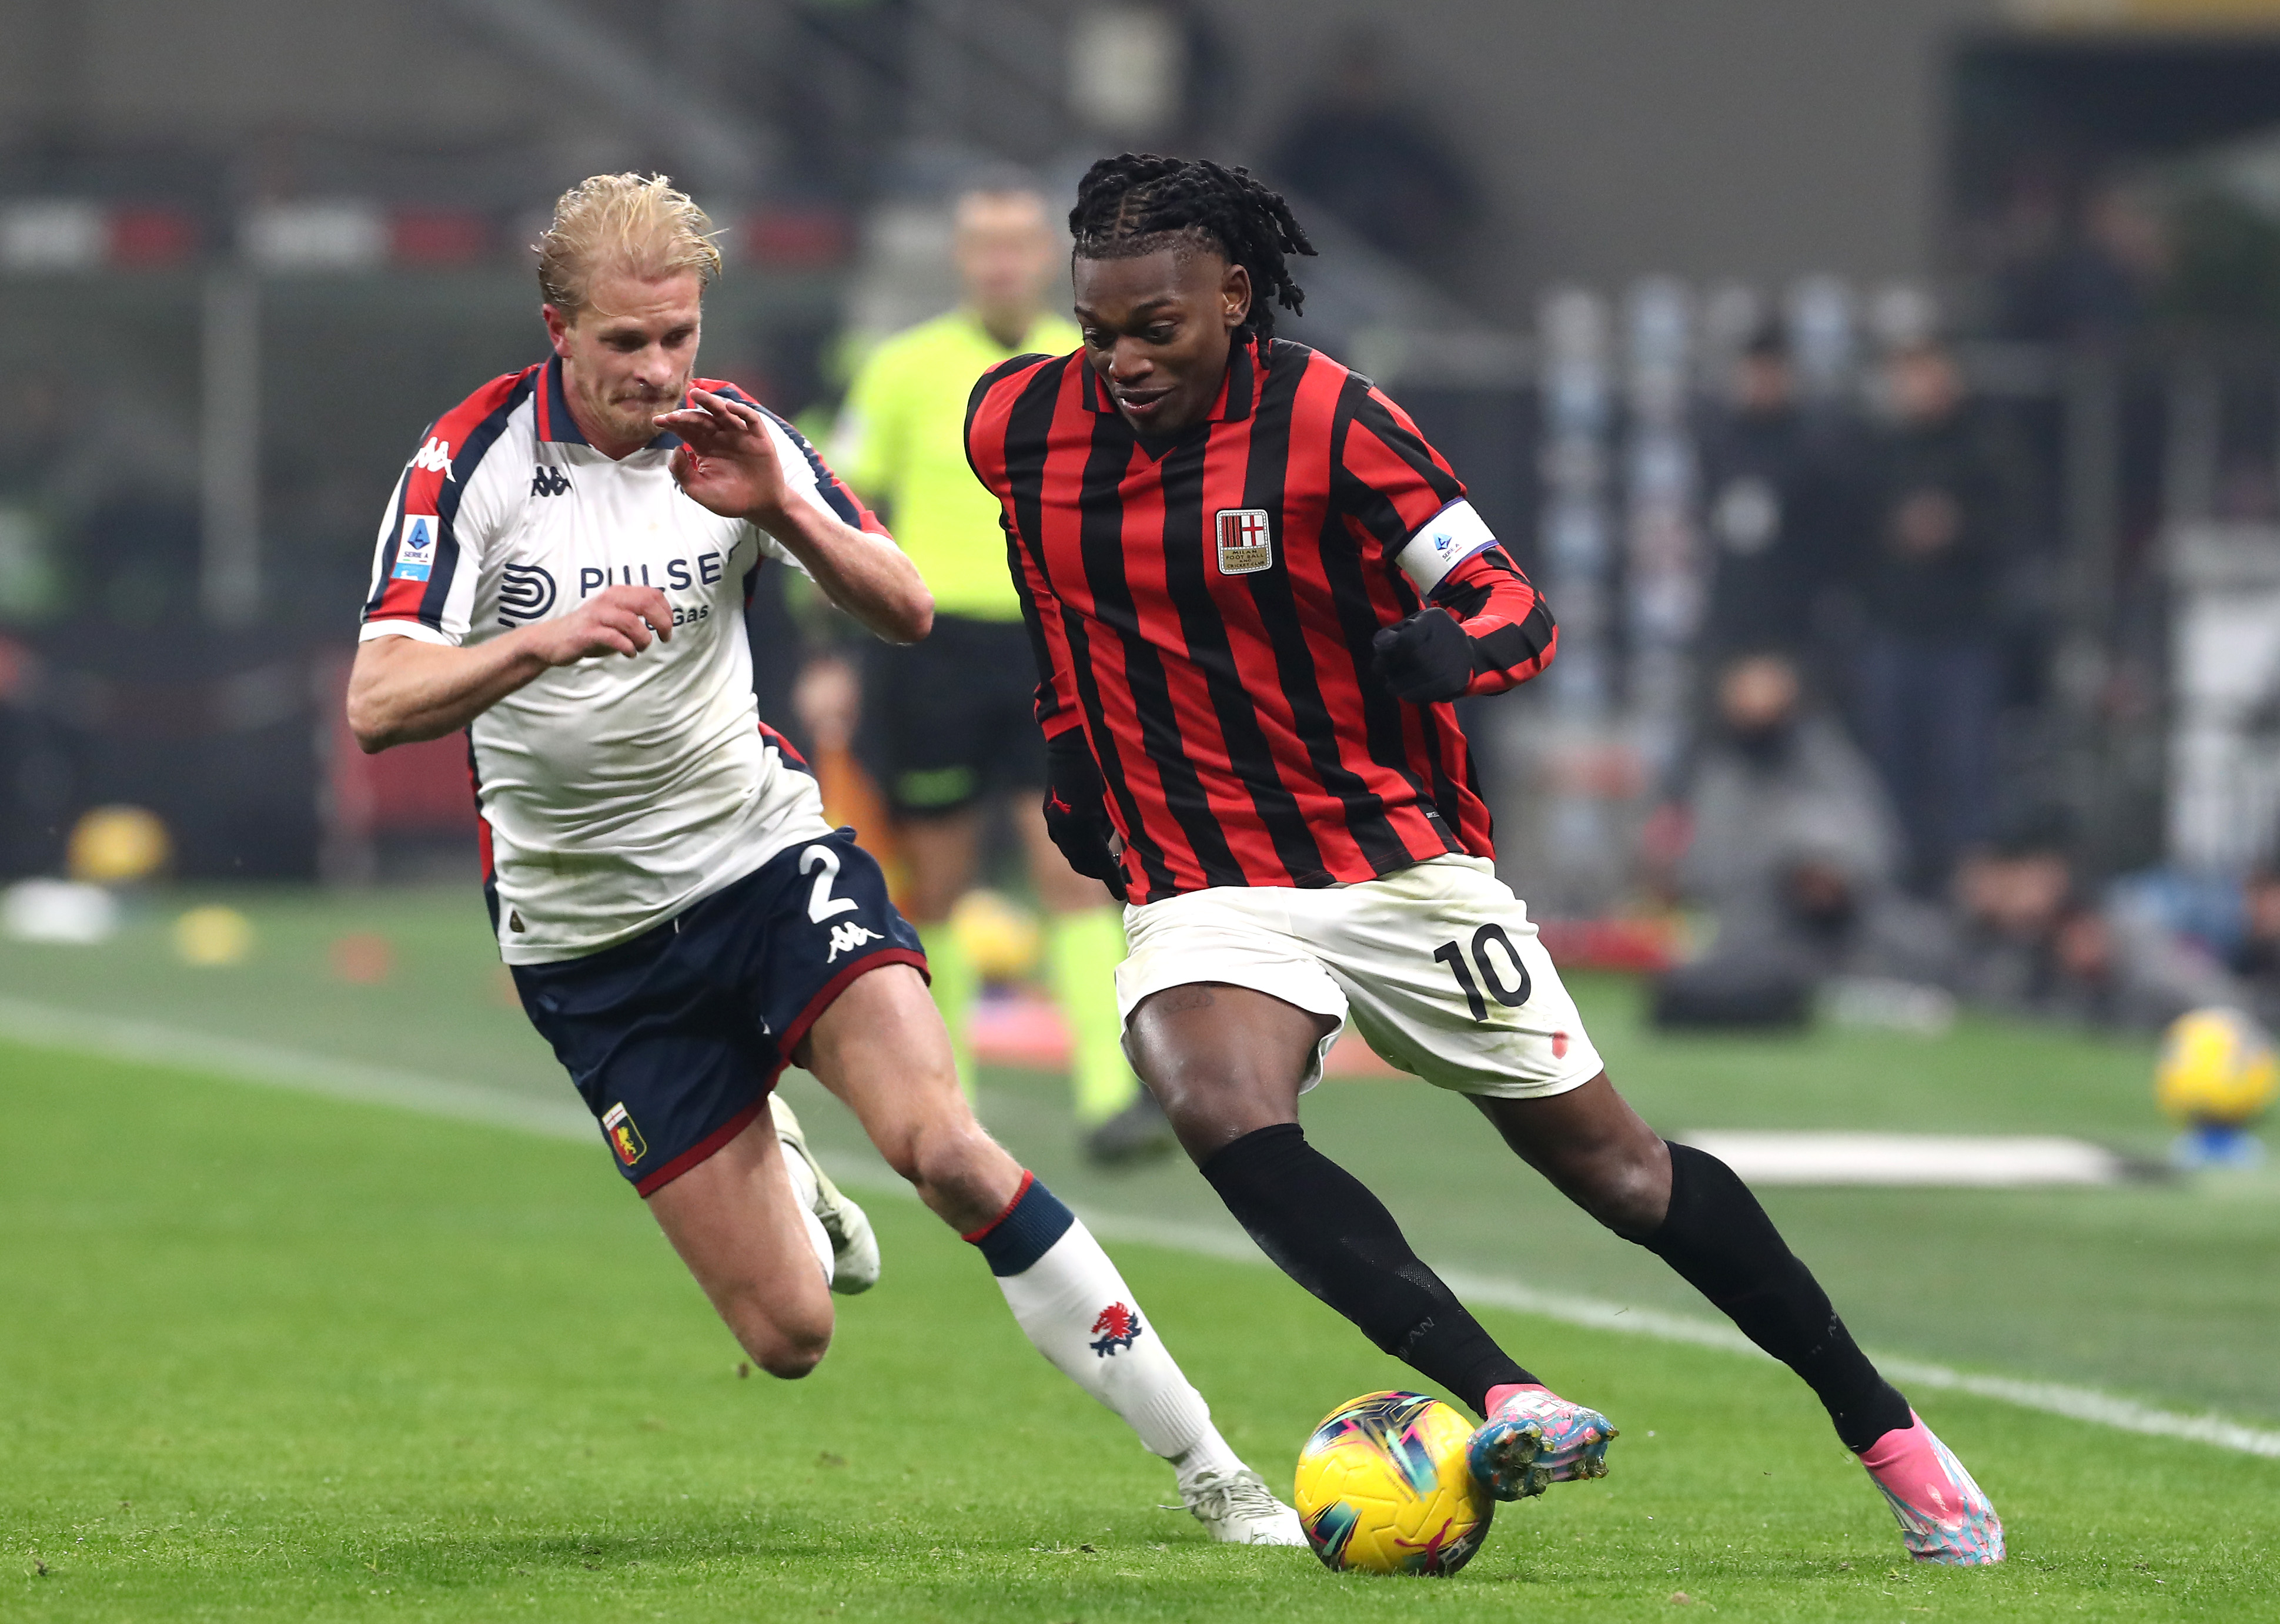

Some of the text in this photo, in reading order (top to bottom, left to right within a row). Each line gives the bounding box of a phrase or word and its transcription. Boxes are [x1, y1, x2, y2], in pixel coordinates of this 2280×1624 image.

[1442, 547, 1455, 560] SERIE
[673, 605, 708, 627] Gas
[799, 844, 858, 924] 2
[1433, 923, 1531, 1022] 10
